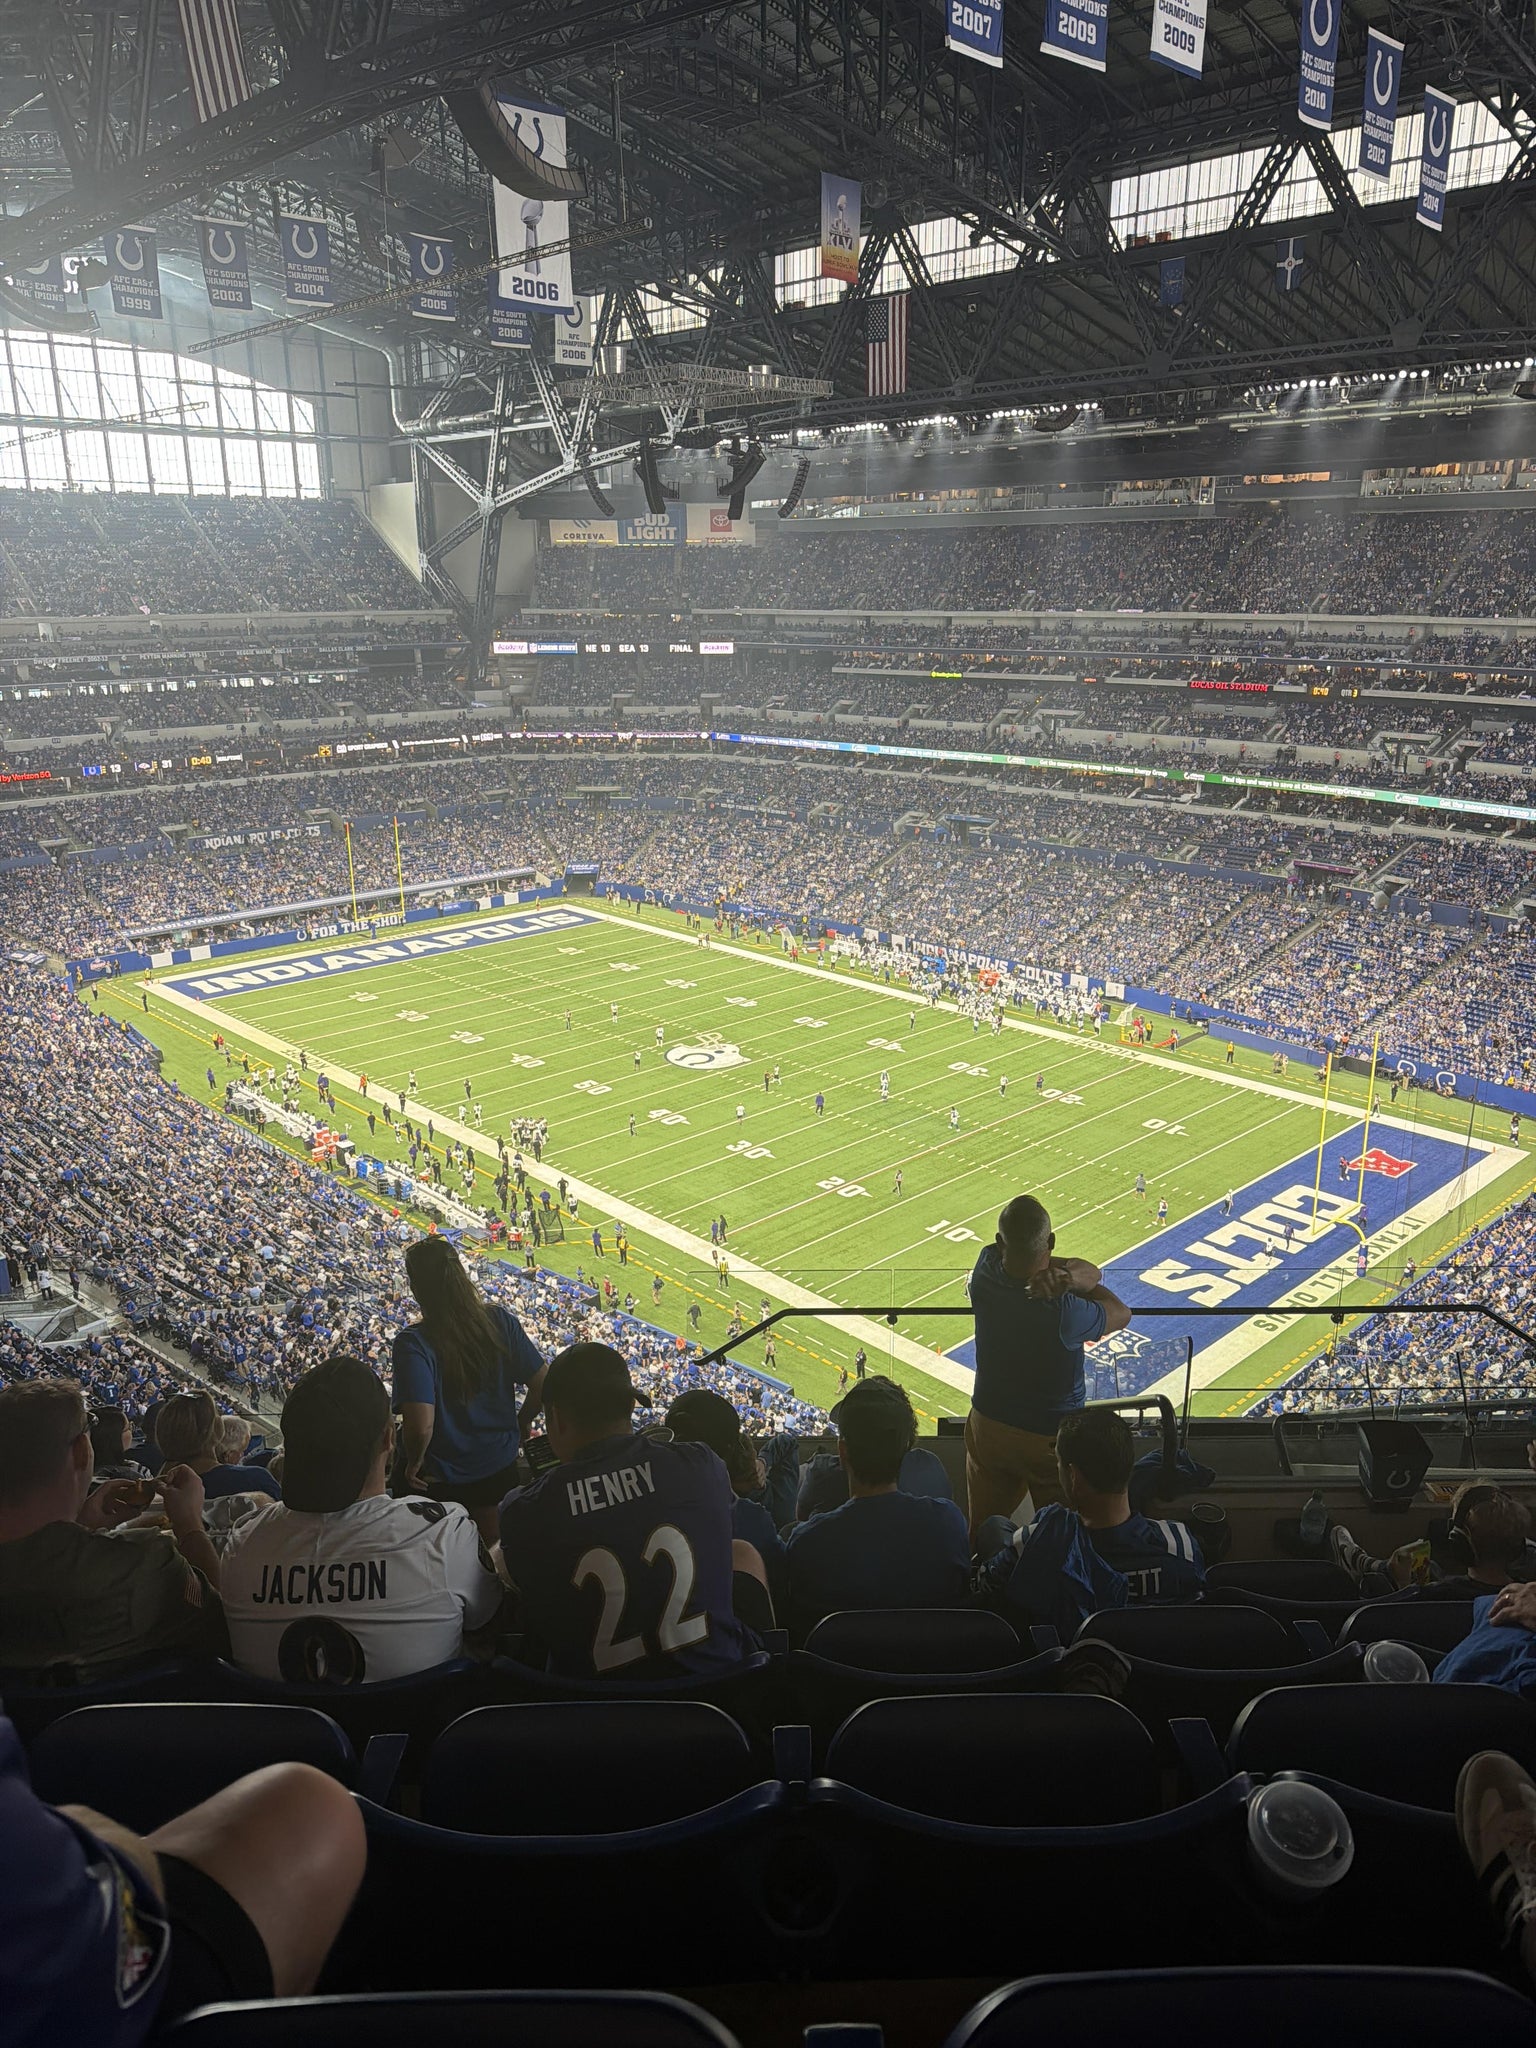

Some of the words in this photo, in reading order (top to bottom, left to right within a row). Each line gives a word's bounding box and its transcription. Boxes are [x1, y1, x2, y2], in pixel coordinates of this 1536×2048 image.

[1060, 0, 1108, 17] AMPIONS
[1158, 0, 1205, 29] CHAMPIONS
[952, 1, 992, 39] 2007
[1058, 11, 1097, 45] 2009
[1164, 23, 1196, 54] 2009
[1301, 64, 1335, 87] CHAMPIONS
[1305, 87, 1326, 110] 2010
[1363, 122, 1394, 144] CHAMPIONS
[1367, 144, 1386, 165] 2013
[1422, 191, 1439, 213] 2014
[220, 270, 247, 280] SOUTH
[287, 270, 330, 283] CHAMPIONS
[288, 263, 301, 272] AFC
[302, 264, 328, 275] SOUTH
[35, 282, 58, 292] EAST
[113, 275, 130, 285] AFC
[131, 277, 154, 287] EAST
[294, 282, 325, 297] 2004
[512, 276, 559, 301] 2006
[120, 295, 151, 311] 1999
[212, 288, 243, 302] 2003
[421, 297, 447, 310] 2005
[492, 316, 528, 327] CHAMPIONS
[506, 311, 527, 319] SOUTH
[498, 327, 523, 339] 2006
[556, 339, 591, 348] CHAMPIONS
[562, 349, 586, 360] 2006
[633, 513, 670, 527] BUD
[627, 527, 677, 540] LIGHT
[705, 536, 737, 544] TOYOTA
[585, 644, 597, 653] NE
[601, 644, 610, 653] 10
[619, 644, 636, 653] SEA
[639, 644, 649, 653] 13
[669, 644, 693, 653] FINAL
[1190, 681, 1215, 690] LUCAS
[1215, 682, 1229, 690] OIL
[1230, 682, 1269, 692] STADIUM
[1312, 687, 1329, 696] 0:40
[1341, 688, 1352, 697] QTR
[320, 746, 332, 756] 25
[110, 764, 122, 773] 13
[161, 759, 172, 768] 31
[191, 756, 212, 766] 0:40
[12, 773, 39, 781] Verizon
[1222, 775, 1235, 783] Find
[1440, 800, 1452, 808] Get
[1453, 800, 1463, 808] the
[1464, 803, 1508, 816] money-saving
[1509, 808, 1529, 818] scoop
[130, 924, 163, 935] LUCAS
[184, 914, 231, 926] STADIUM
[311, 925, 338, 940] FOR
[341, 920, 369, 934] THE
[187, 908, 587, 995] INDIANAPOLIS
[1016, 963, 1063, 987] COLTS
[573, 1079, 613, 1096] 50
[1042, 1088, 1081, 1105] 20
[648, 1108, 685, 1125] 40
[1142, 1118, 1186, 1136] 10
[725, 1140, 770, 1159] 30
[816, 1175, 866, 1198] 20
[925, 1219, 975, 1242] 10
[1398, 1216, 1427, 1231] IT
[1138, 1184, 1366, 1308] COLTS
[1309, 1265, 1356, 1290] ALL
[1253, 1313, 1292, 1332] US
[567, 1461, 656, 1517] HENRY
[252, 1560, 387, 1604] JACKSON
[570, 1523, 709, 1672] 22
